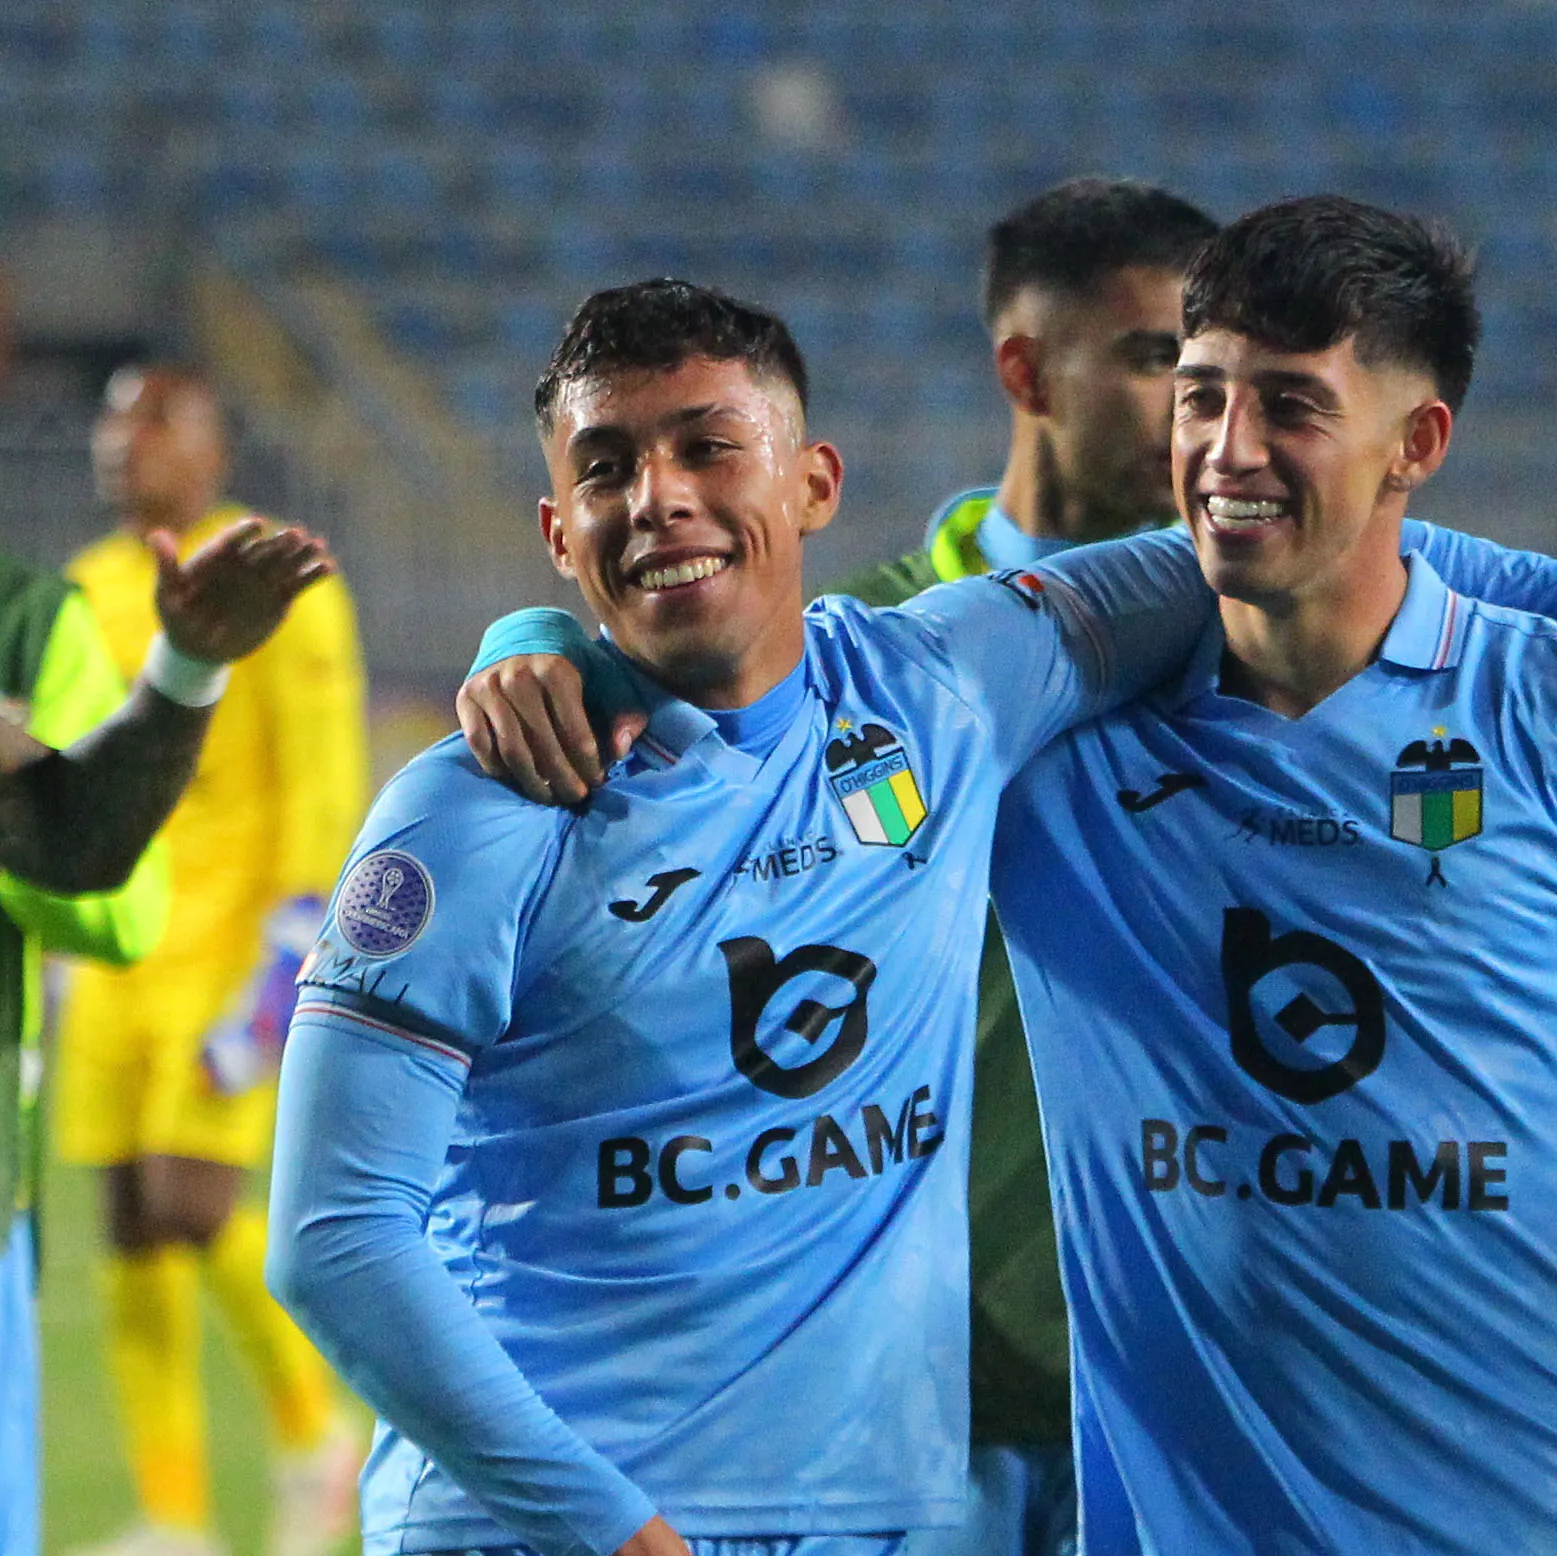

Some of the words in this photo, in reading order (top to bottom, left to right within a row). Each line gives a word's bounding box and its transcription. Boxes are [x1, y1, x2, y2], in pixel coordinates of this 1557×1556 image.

[752, 836, 837, 882] MEDS
[1269, 818, 1360, 848] MEDS
[597, 1084, 946, 1210] BC.GAME
[1140, 1118, 1510, 1212] BC.GAME
